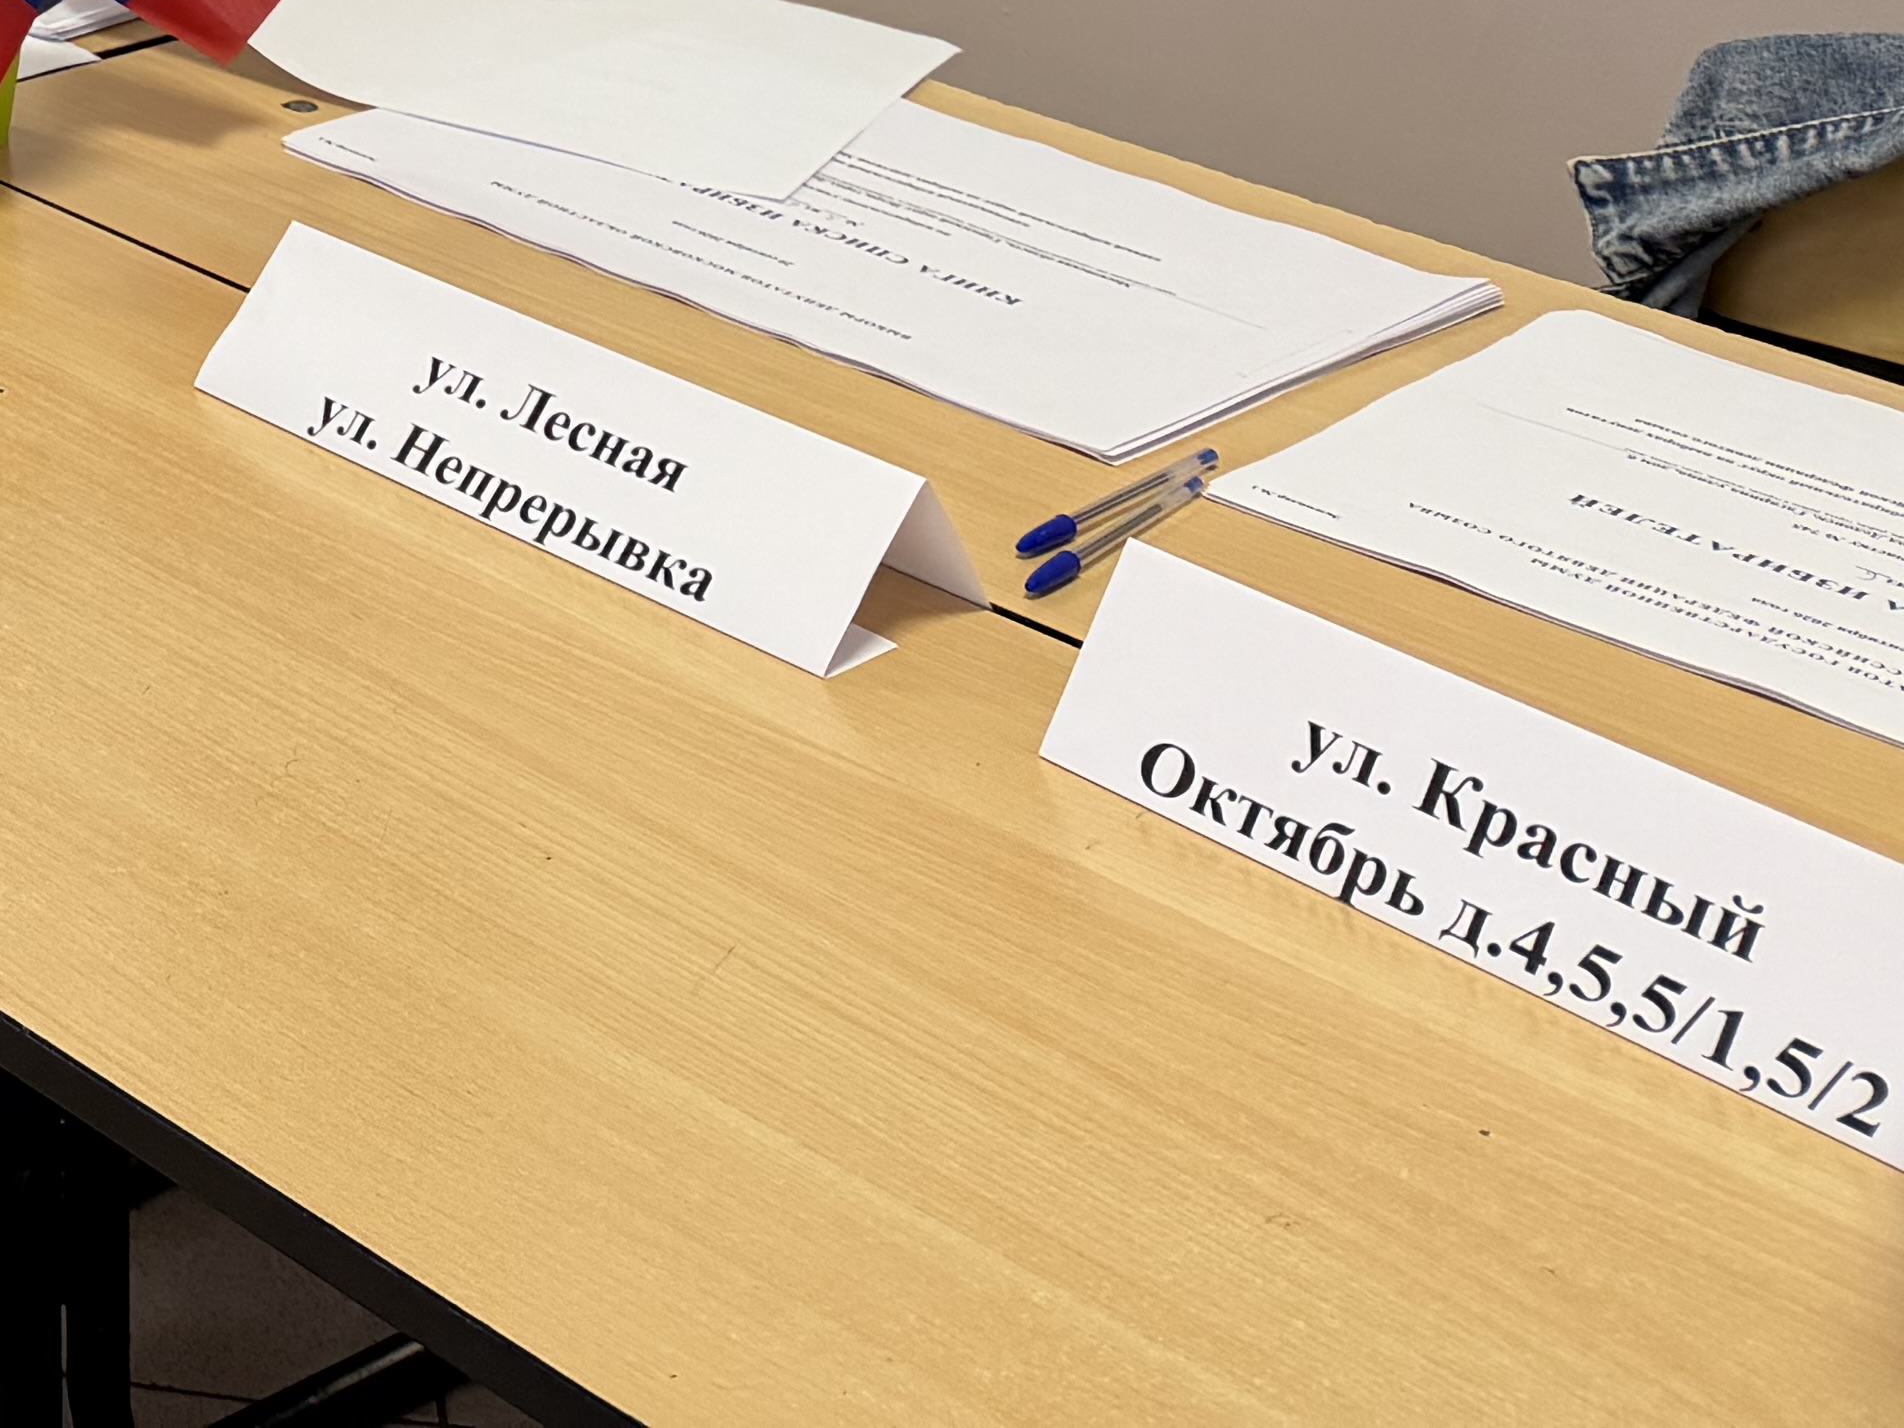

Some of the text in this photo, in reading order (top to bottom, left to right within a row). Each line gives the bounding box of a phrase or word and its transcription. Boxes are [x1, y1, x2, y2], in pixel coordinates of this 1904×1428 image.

[792, 219, 909, 264] СПИСКА
[920, 264, 1022, 306] КНИГА
[412, 354, 689, 495] ул. Лесная
[307, 395, 715, 604] ул. Непрерывка
[1570, 494, 1868, 600] ИЗБИРАТЕЛЕЙ
[1292, 721, 1764, 962] ул. Красный
[1141, 743, 1888, 1137] Октябрь д.4,5,5/1,5/2
